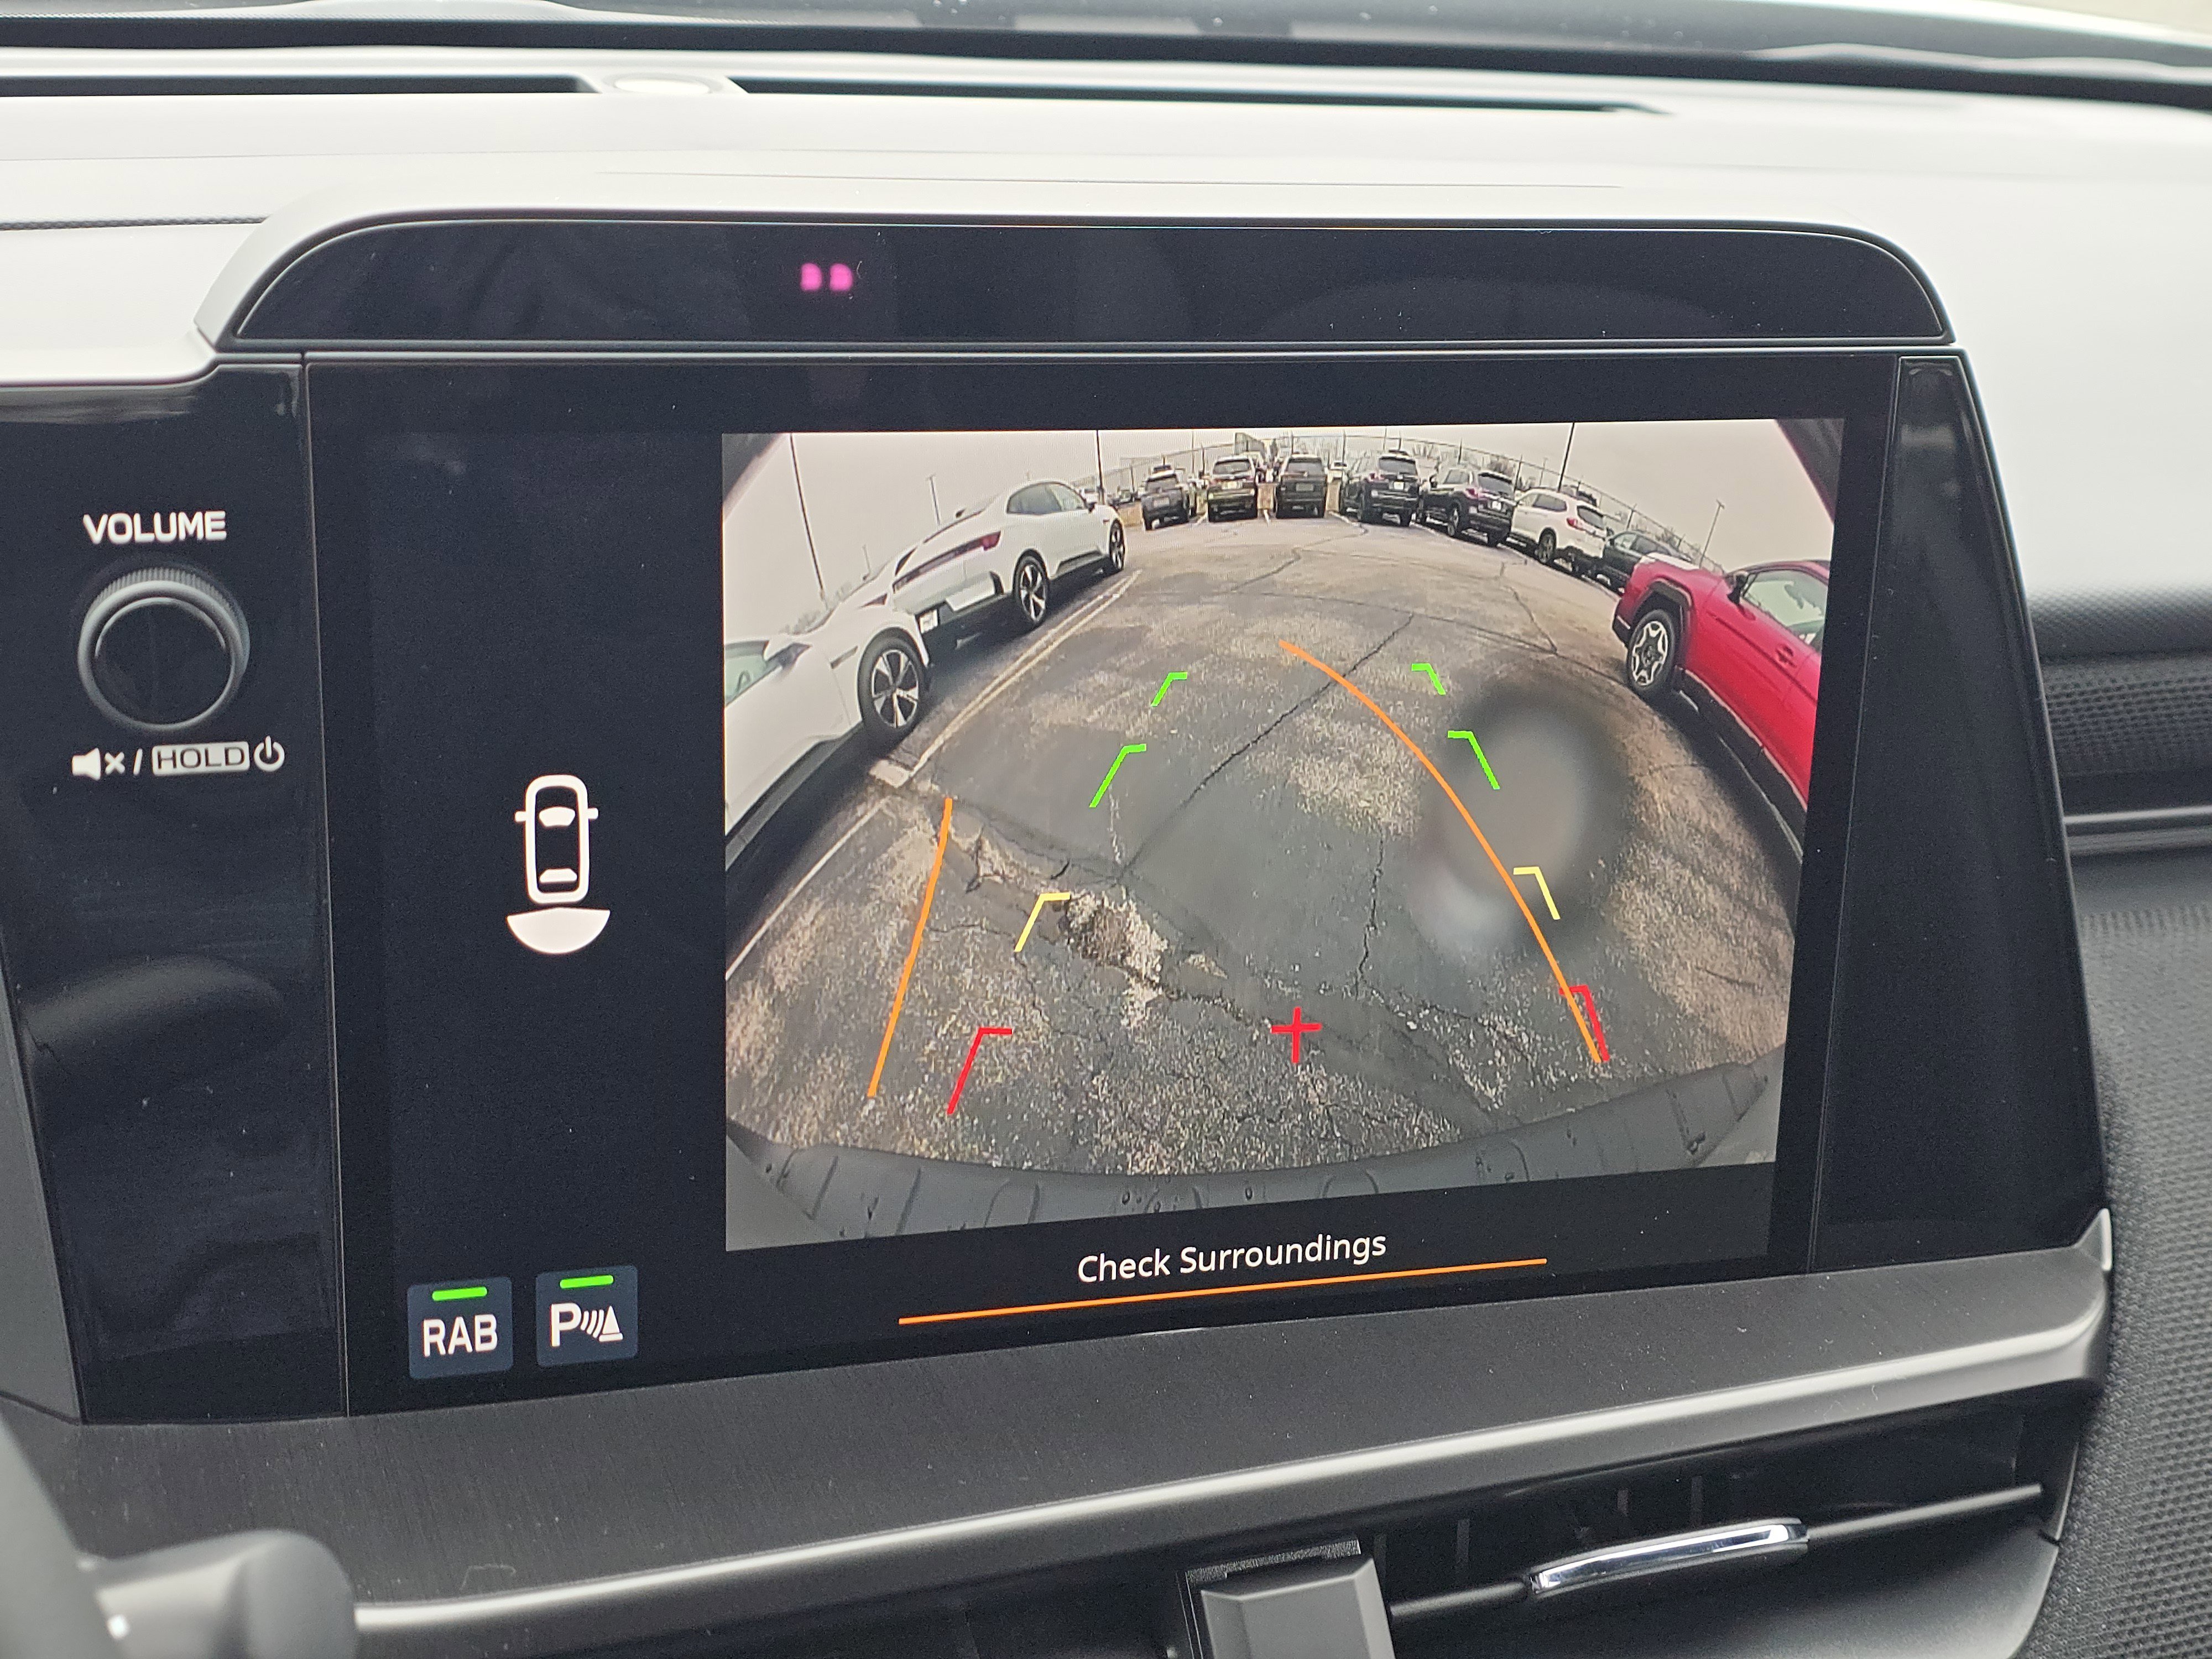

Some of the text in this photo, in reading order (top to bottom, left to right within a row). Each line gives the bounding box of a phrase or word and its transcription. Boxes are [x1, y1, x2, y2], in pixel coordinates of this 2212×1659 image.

[82, 510, 227, 544] VOLUME
[156, 747, 245, 770] HOLD
[1078, 1234, 1387, 1282] Check Surroundings
[422, 1313, 498, 1358] RAB
[551, 1302, 581, 1347] P
